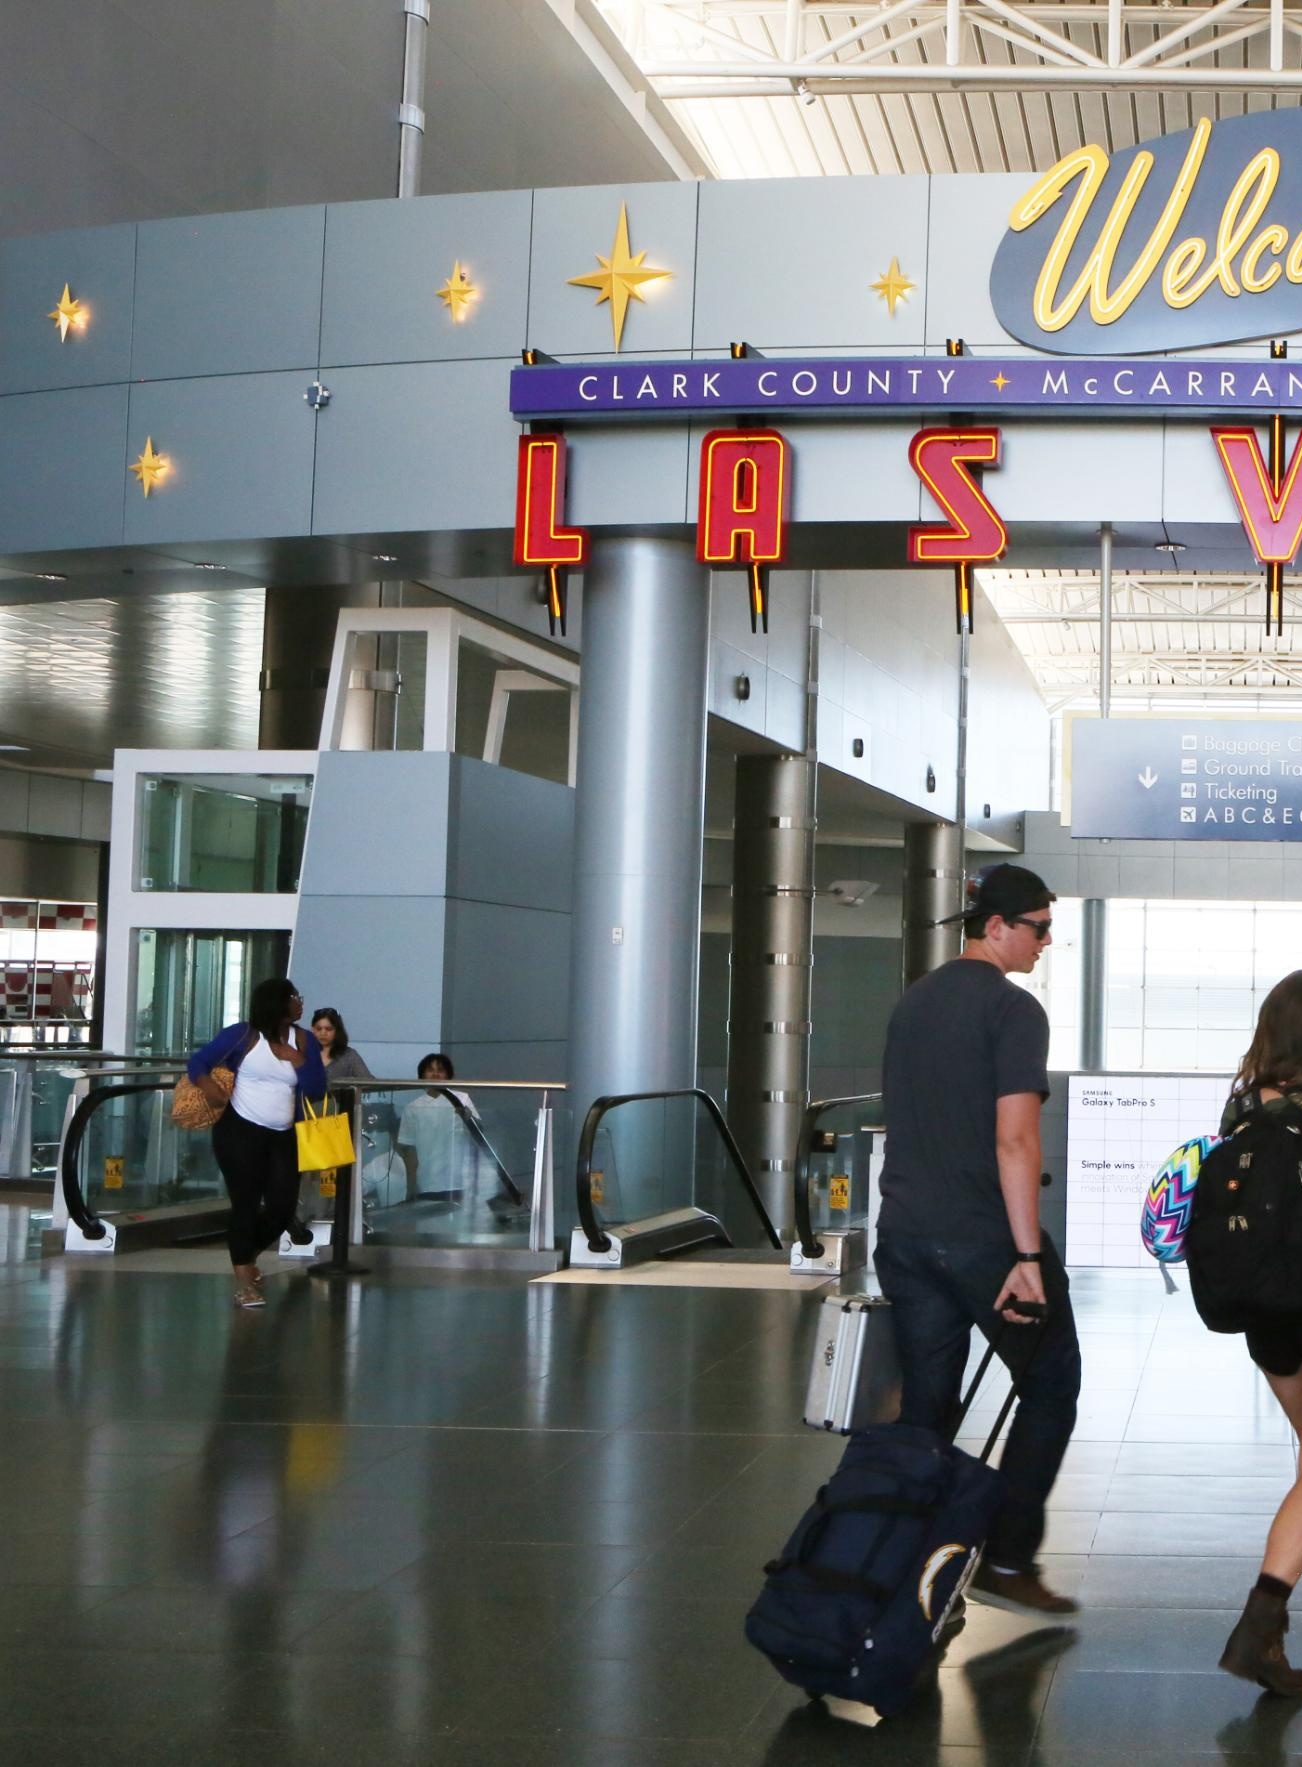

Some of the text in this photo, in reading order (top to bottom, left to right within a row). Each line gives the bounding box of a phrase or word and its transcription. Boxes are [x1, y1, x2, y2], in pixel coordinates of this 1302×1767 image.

[578, 373, 721, 401] CLARK
[757, 369, 955, 397] COUNTY
[513, 427, 1008, 566] LAS
[1204, 735, 1281, 755] Baggage
[1204, 758, 1271, 776] Ground
[1204, 782, 1278, 804] Ticketing
[1204, 807, 1218, 823] A
[1224, 807, 1235, 823] B
[1241, 807, 1257, 824] C
[1262, 808, 1276, 824] &
[1283, 808, 1293, 824] E
[1082, 1098, 1156, 1107] Galaxy TabPro S
[1081, 1159, 1112, 1170] Simple
[1113, 1161, 1136, 1169] wins
